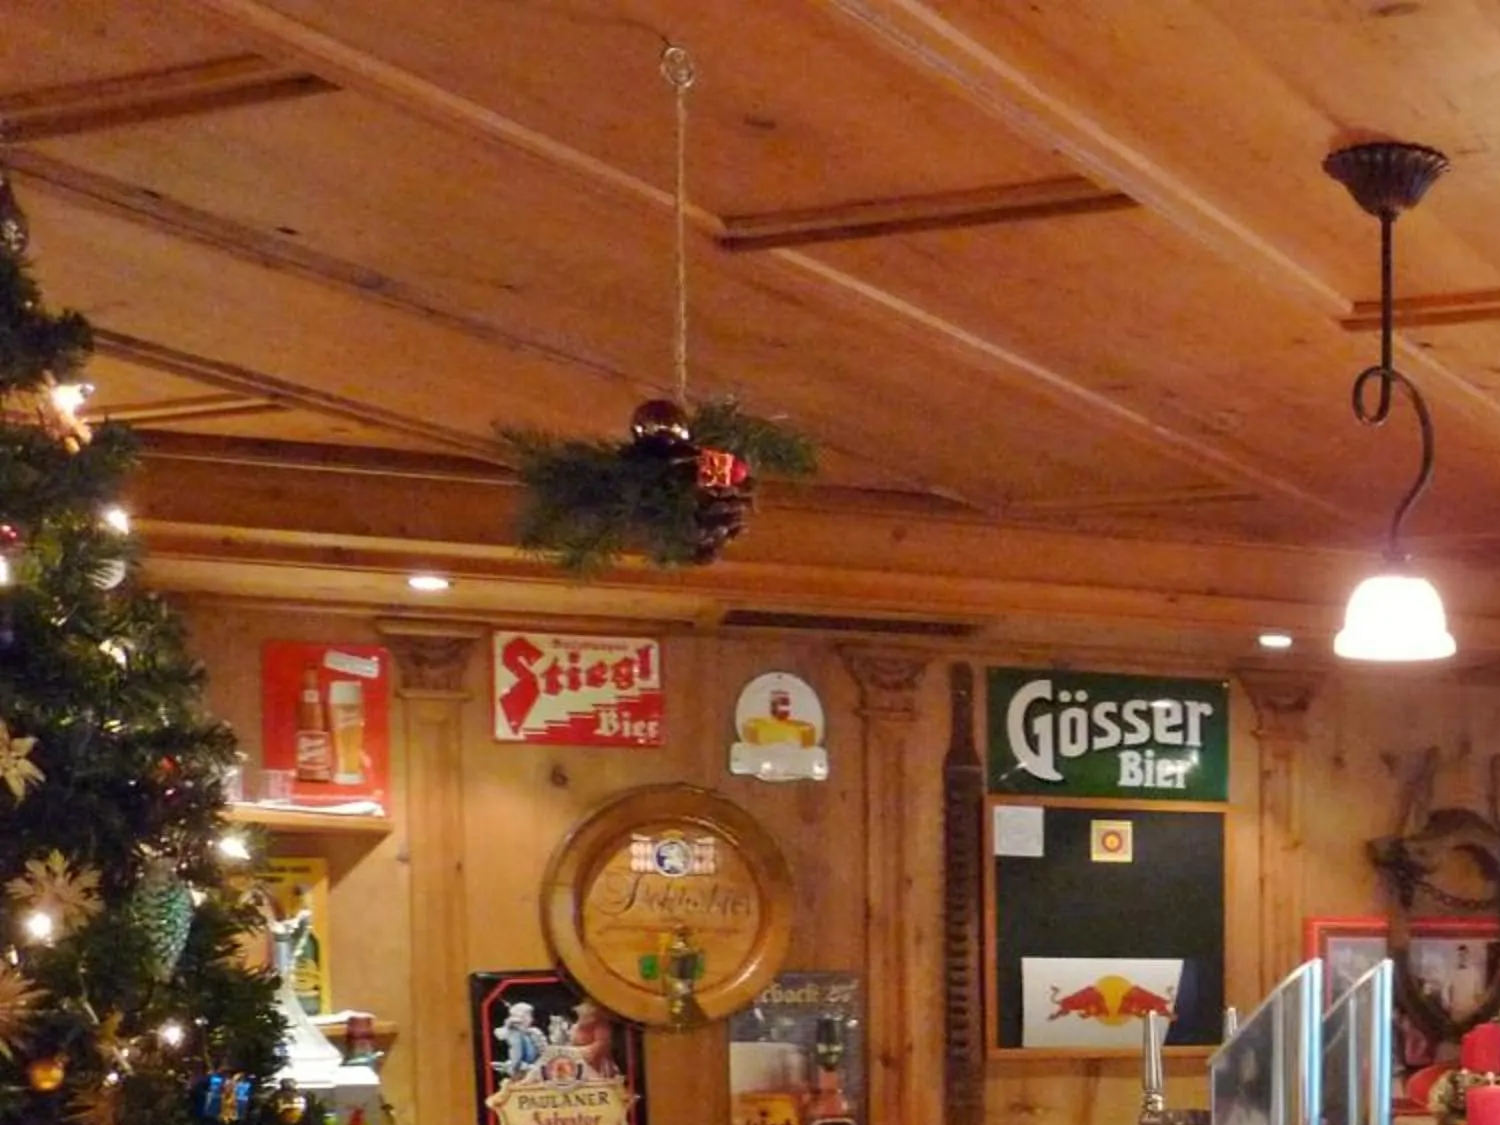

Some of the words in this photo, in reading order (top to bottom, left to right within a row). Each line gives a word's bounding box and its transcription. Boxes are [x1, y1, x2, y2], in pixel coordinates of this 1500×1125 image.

[500, 636, 654, 735] Stiegl
[594, 709, 660, 739] Bier
[1007, 679, 1214, 782] Gösser
[1116, 749, 1190, 789] Bier
[517, 1090, 611, 1111] PAULANER
